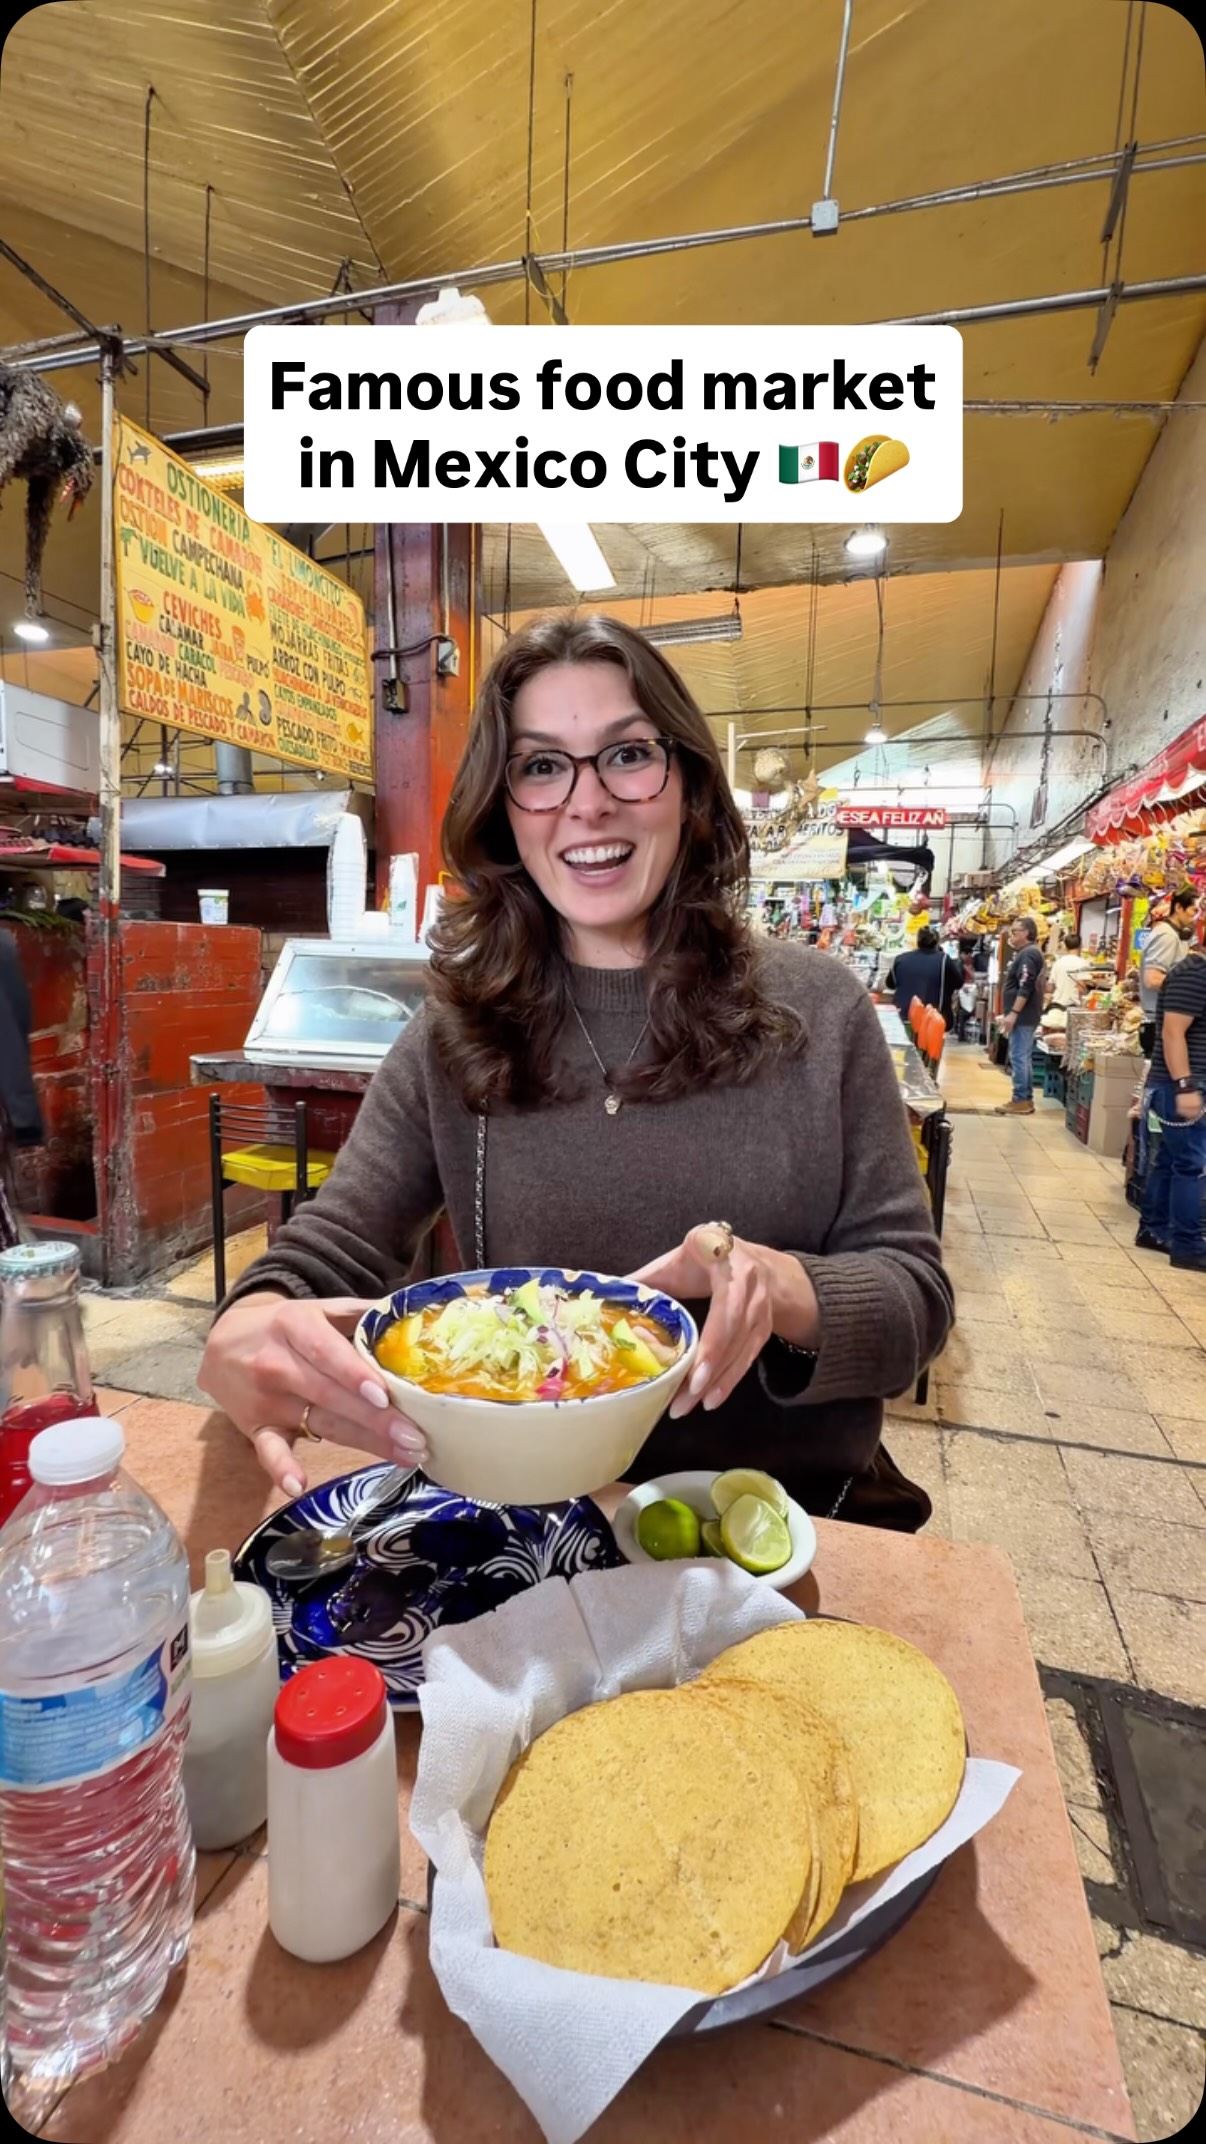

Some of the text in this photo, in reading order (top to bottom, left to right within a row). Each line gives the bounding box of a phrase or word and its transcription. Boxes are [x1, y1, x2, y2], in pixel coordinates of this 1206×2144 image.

[167, 460, 250, 545] OSTIONERIA
[185, 508, 200, 538] DE
[140, 537, 184, 584] VUELVE
[188, 567, 198, 591] A
[202, 575, 216, 602] LA
[173, 527, 243, 591] CAMPECHANA
[163, 590, 221, 639] CEVICHES
[127, 641, 206, 686] CAYO DE HACHA
[302, 661, 318, 683] CON
[127, 663, 233, 719] SOPA DE MARISCOS
[129, 690, 169, 716] CALDOS
[173, 703, 184, 722] DE
[882, 811, 920, 826] FELIZ
